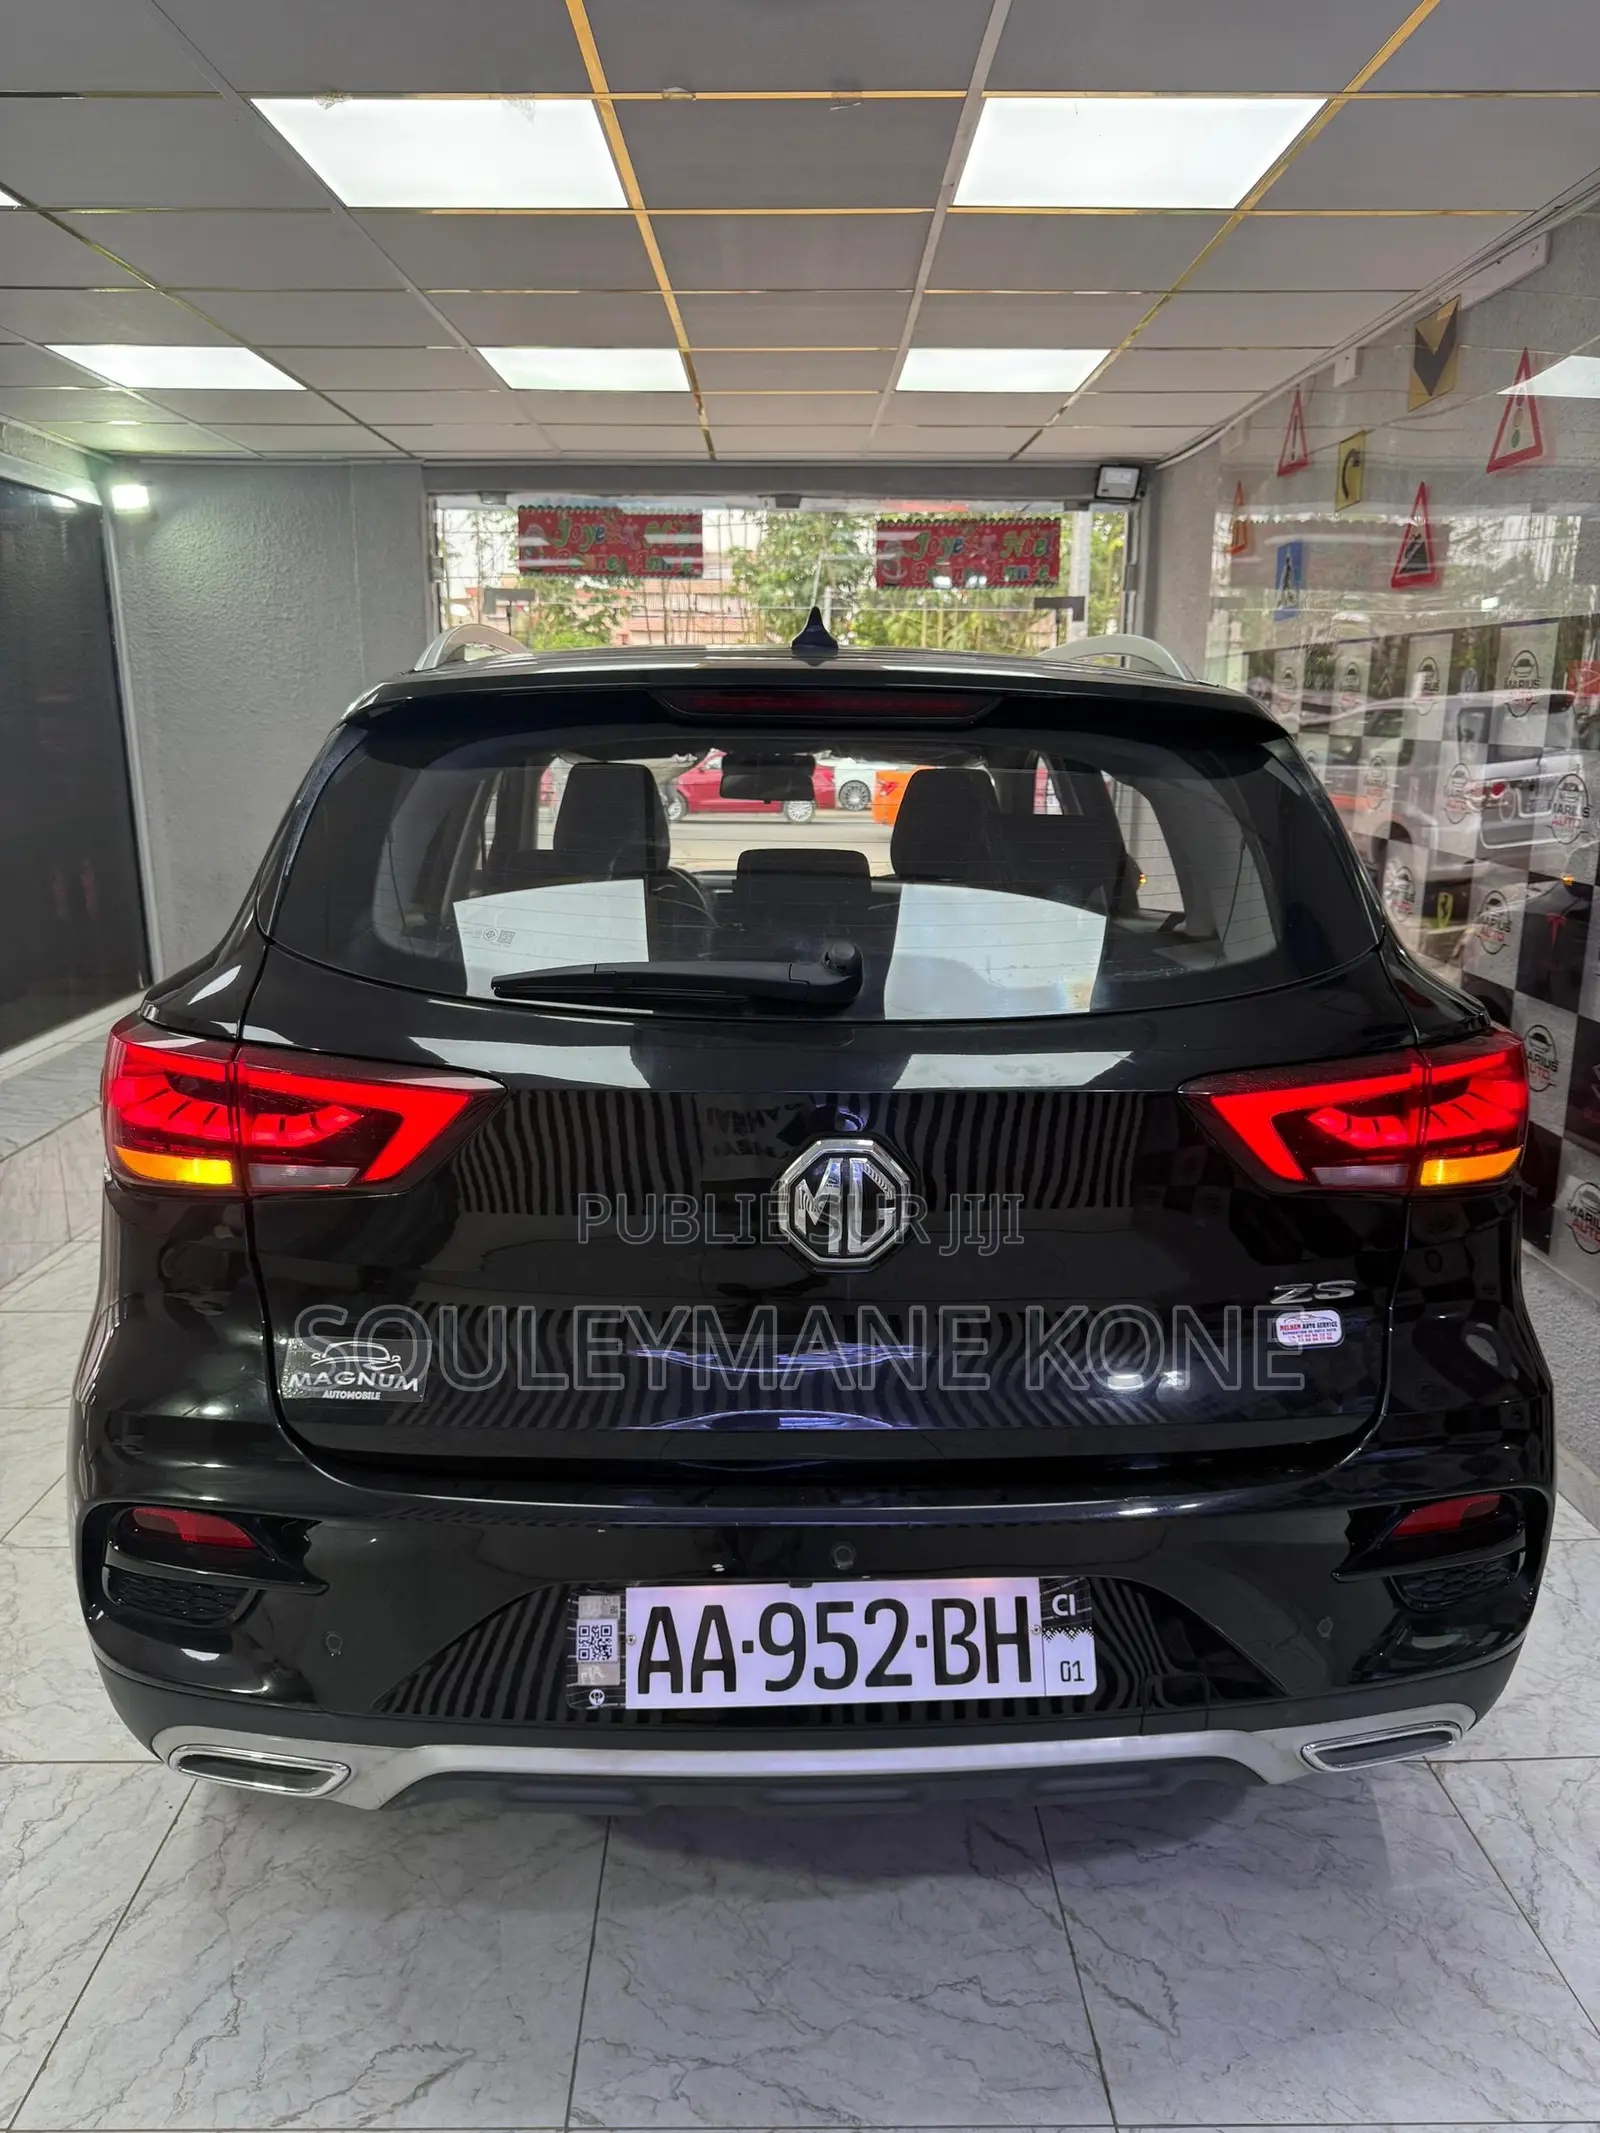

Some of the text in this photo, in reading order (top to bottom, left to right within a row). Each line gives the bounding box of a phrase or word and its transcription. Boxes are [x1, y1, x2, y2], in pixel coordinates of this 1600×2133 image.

[797, 1156, 897, 1256] MG
[1270, 1280, 1357, 1305] ZS
[289, 1371, 419, 1392] MAGNUM
[322, 1390, 382, 1400] AUTOMOBILE
[1051, 1593, 1077, 1617] CI
[1059, 1659, 1085, 1682] 01
